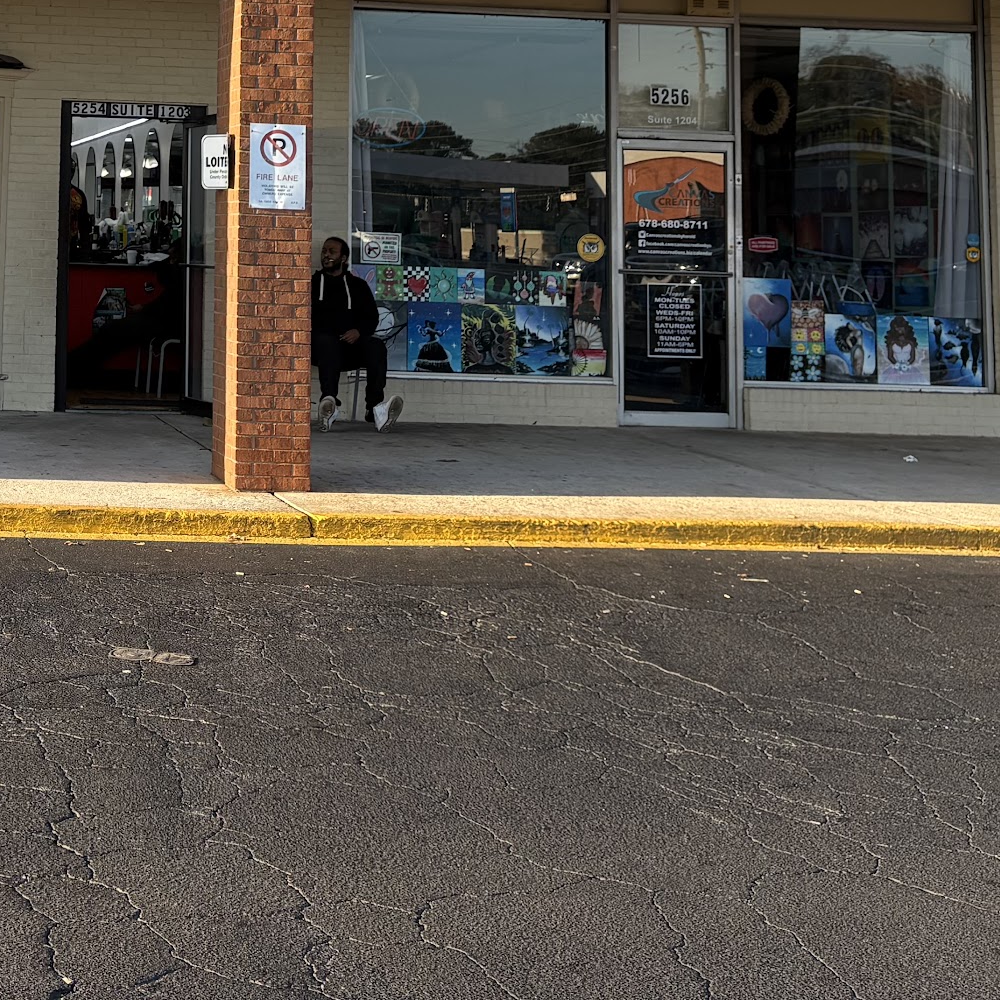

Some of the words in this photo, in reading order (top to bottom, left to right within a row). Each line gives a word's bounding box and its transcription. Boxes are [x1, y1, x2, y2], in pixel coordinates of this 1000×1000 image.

[651, 87, 690, 106] 5256
[72, 102, 106, 114] 5254
[111, 104, 154, 116] SUITE
[160, 106, 191, 118] 1203
[647, 115, 673, 124] Suite
[675, 116, 697, 125] 1204
[256, 173, 273, 181] FIRE
[277, 174, 299, 182] LANE
[658, 197, 716, 208] CREATIONS
[638, 219, 708, 230] 678-680-8711
